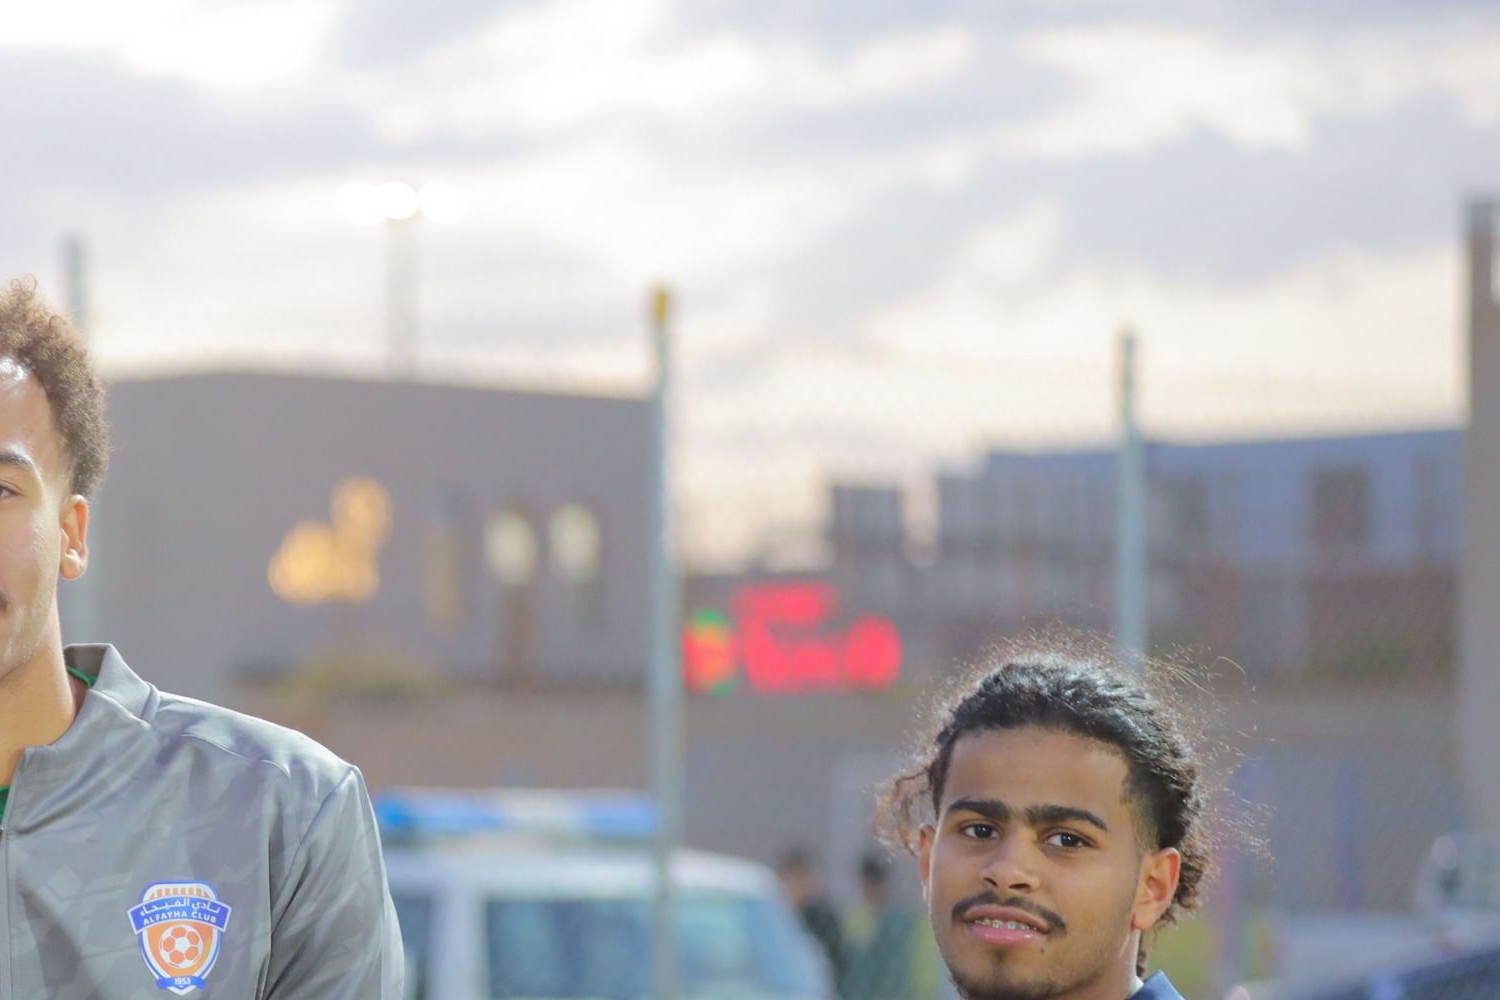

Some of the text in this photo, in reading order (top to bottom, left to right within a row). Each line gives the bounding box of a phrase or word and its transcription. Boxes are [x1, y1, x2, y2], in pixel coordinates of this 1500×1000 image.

[140, 897, 221, 917] نادي الفيحاء
[143, 911, 217, 926] ALFAYHA CLUB
[174, 977, 191, 985] 1953
